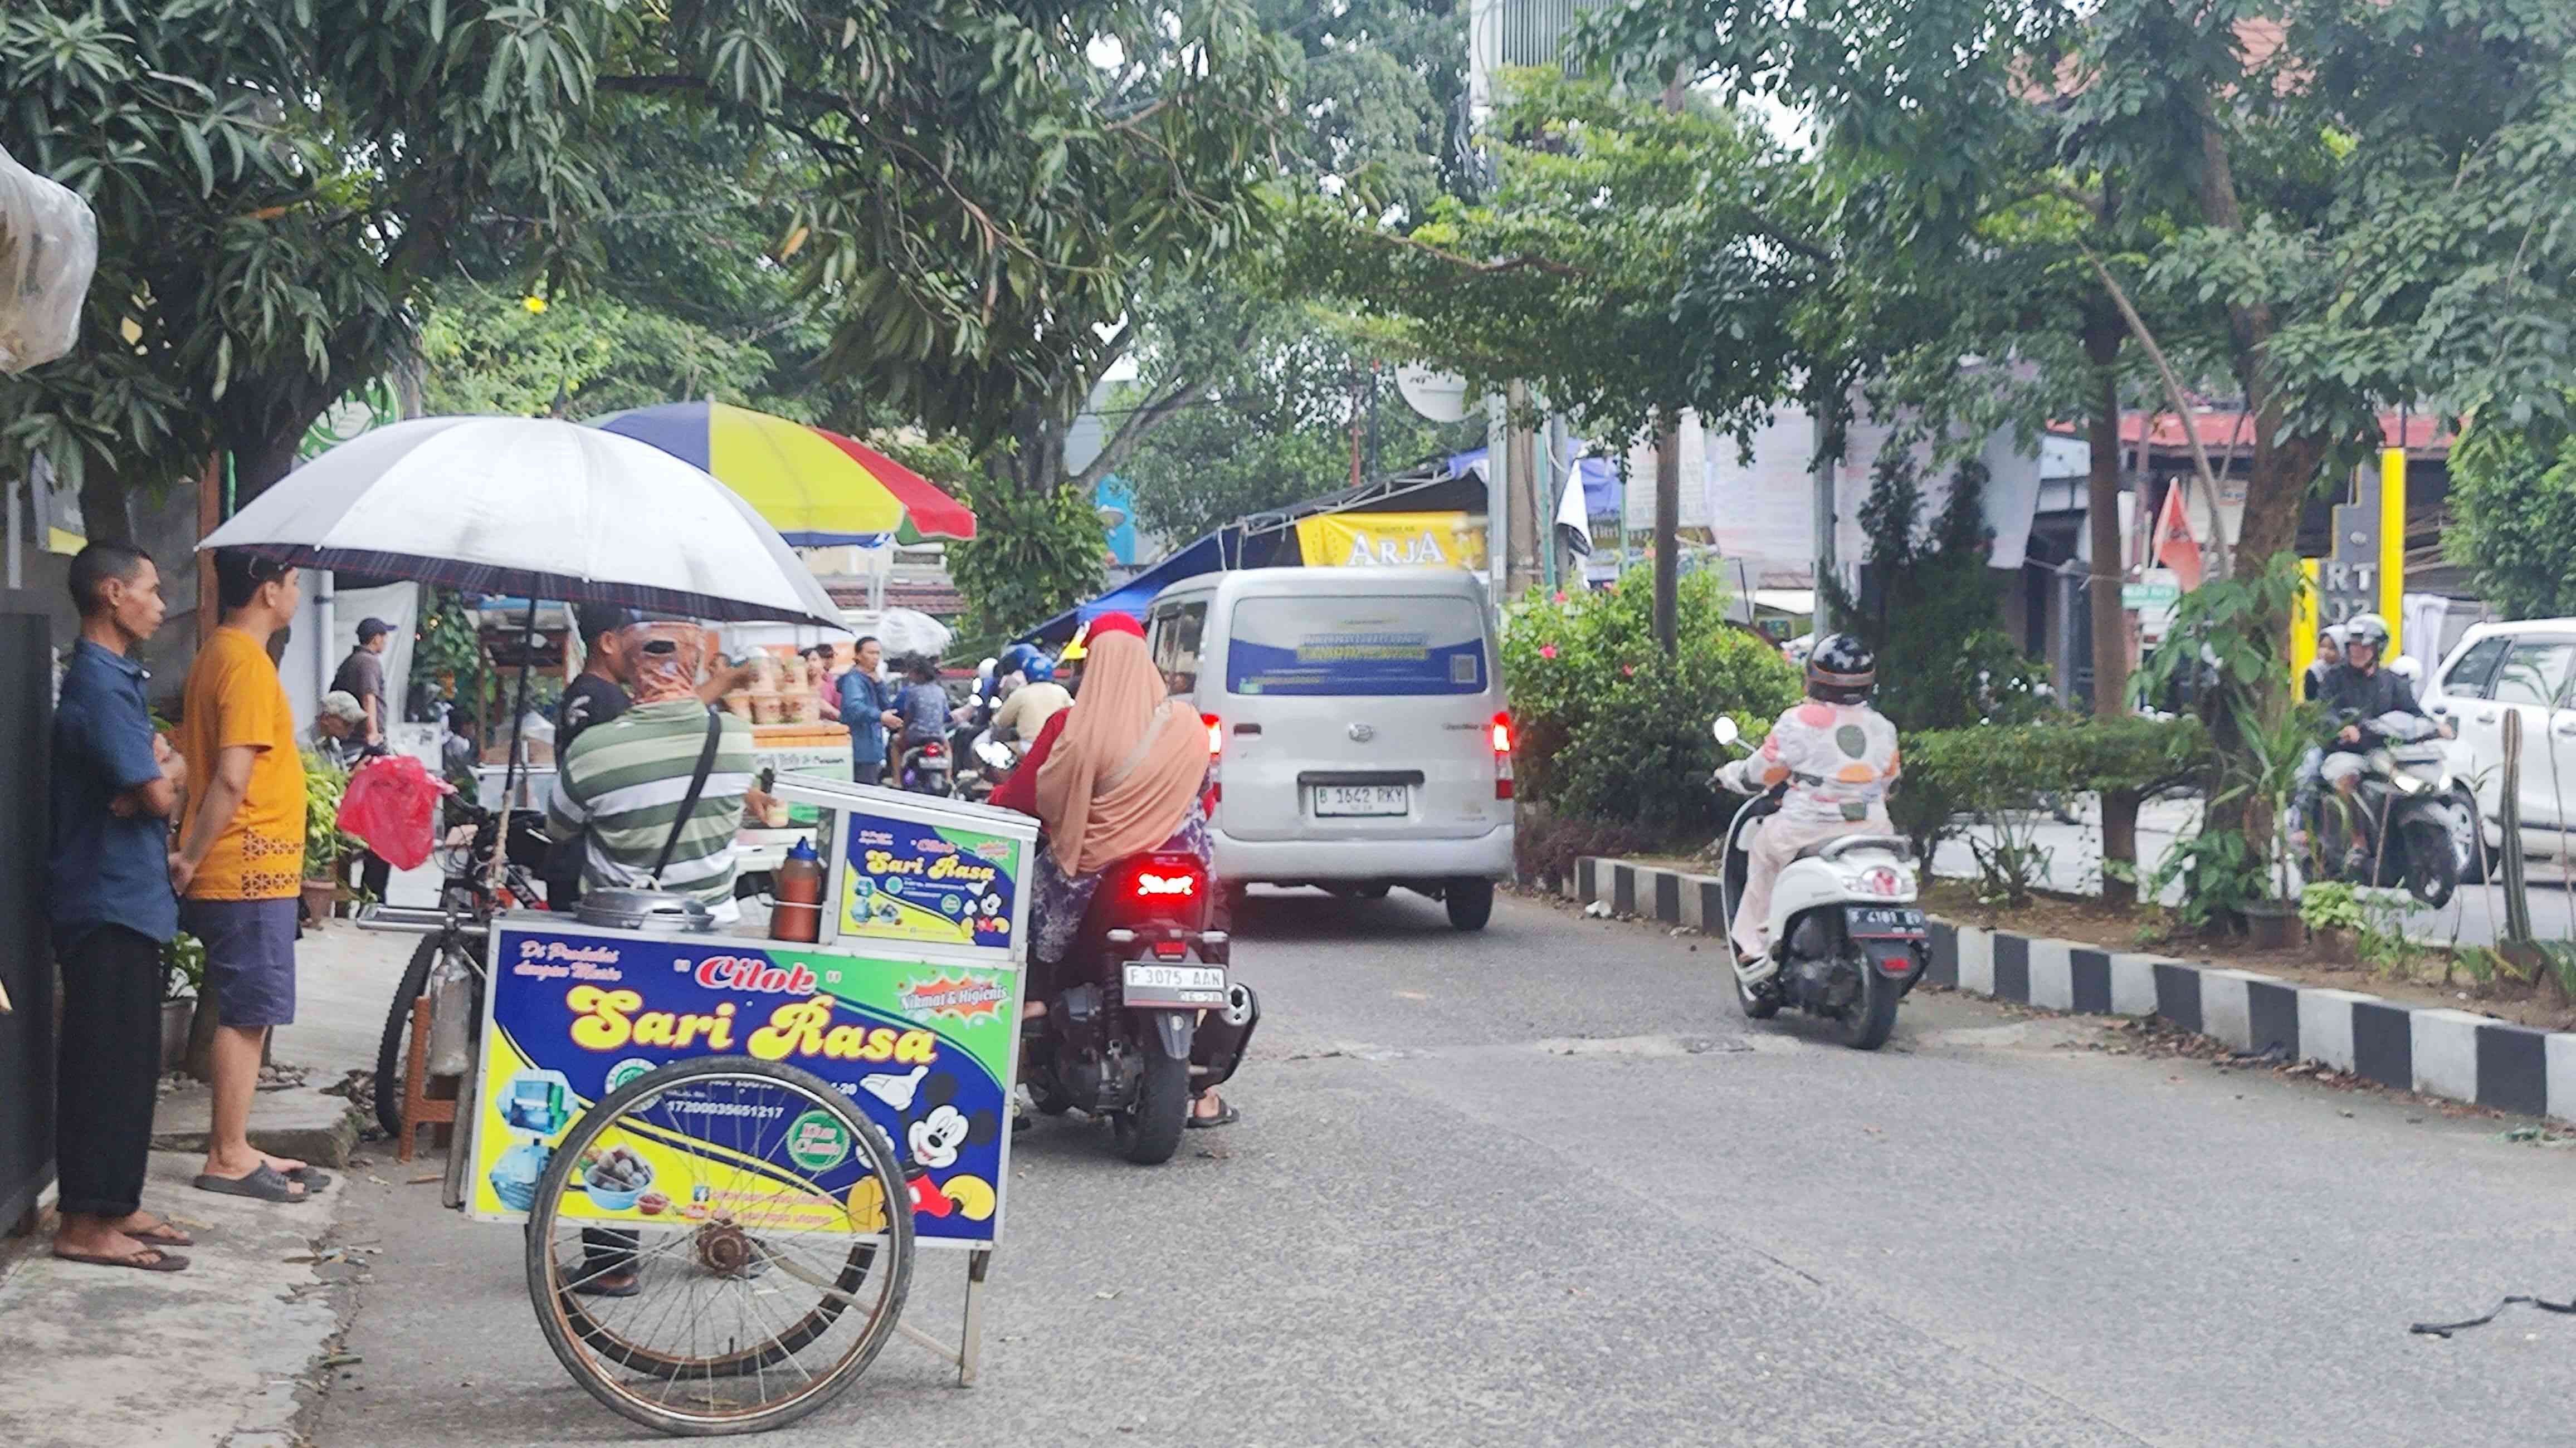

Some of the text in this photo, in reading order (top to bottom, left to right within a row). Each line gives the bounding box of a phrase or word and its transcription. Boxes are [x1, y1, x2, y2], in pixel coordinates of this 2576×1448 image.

[1348, 531, 1446, 566] ARJA
[2326, 561, 2376, 591] RT
[865, 849, 996, 880] Sari Rasa
[695, 956, 818, 995] Cilok
[1130, 968, 1221, 986] F 3075 AAN
[900, 992, 945, 1010] Nikmat
[947, 990, 958, 1005] &
[566, 984, 938, 1063] Sari Rasa
